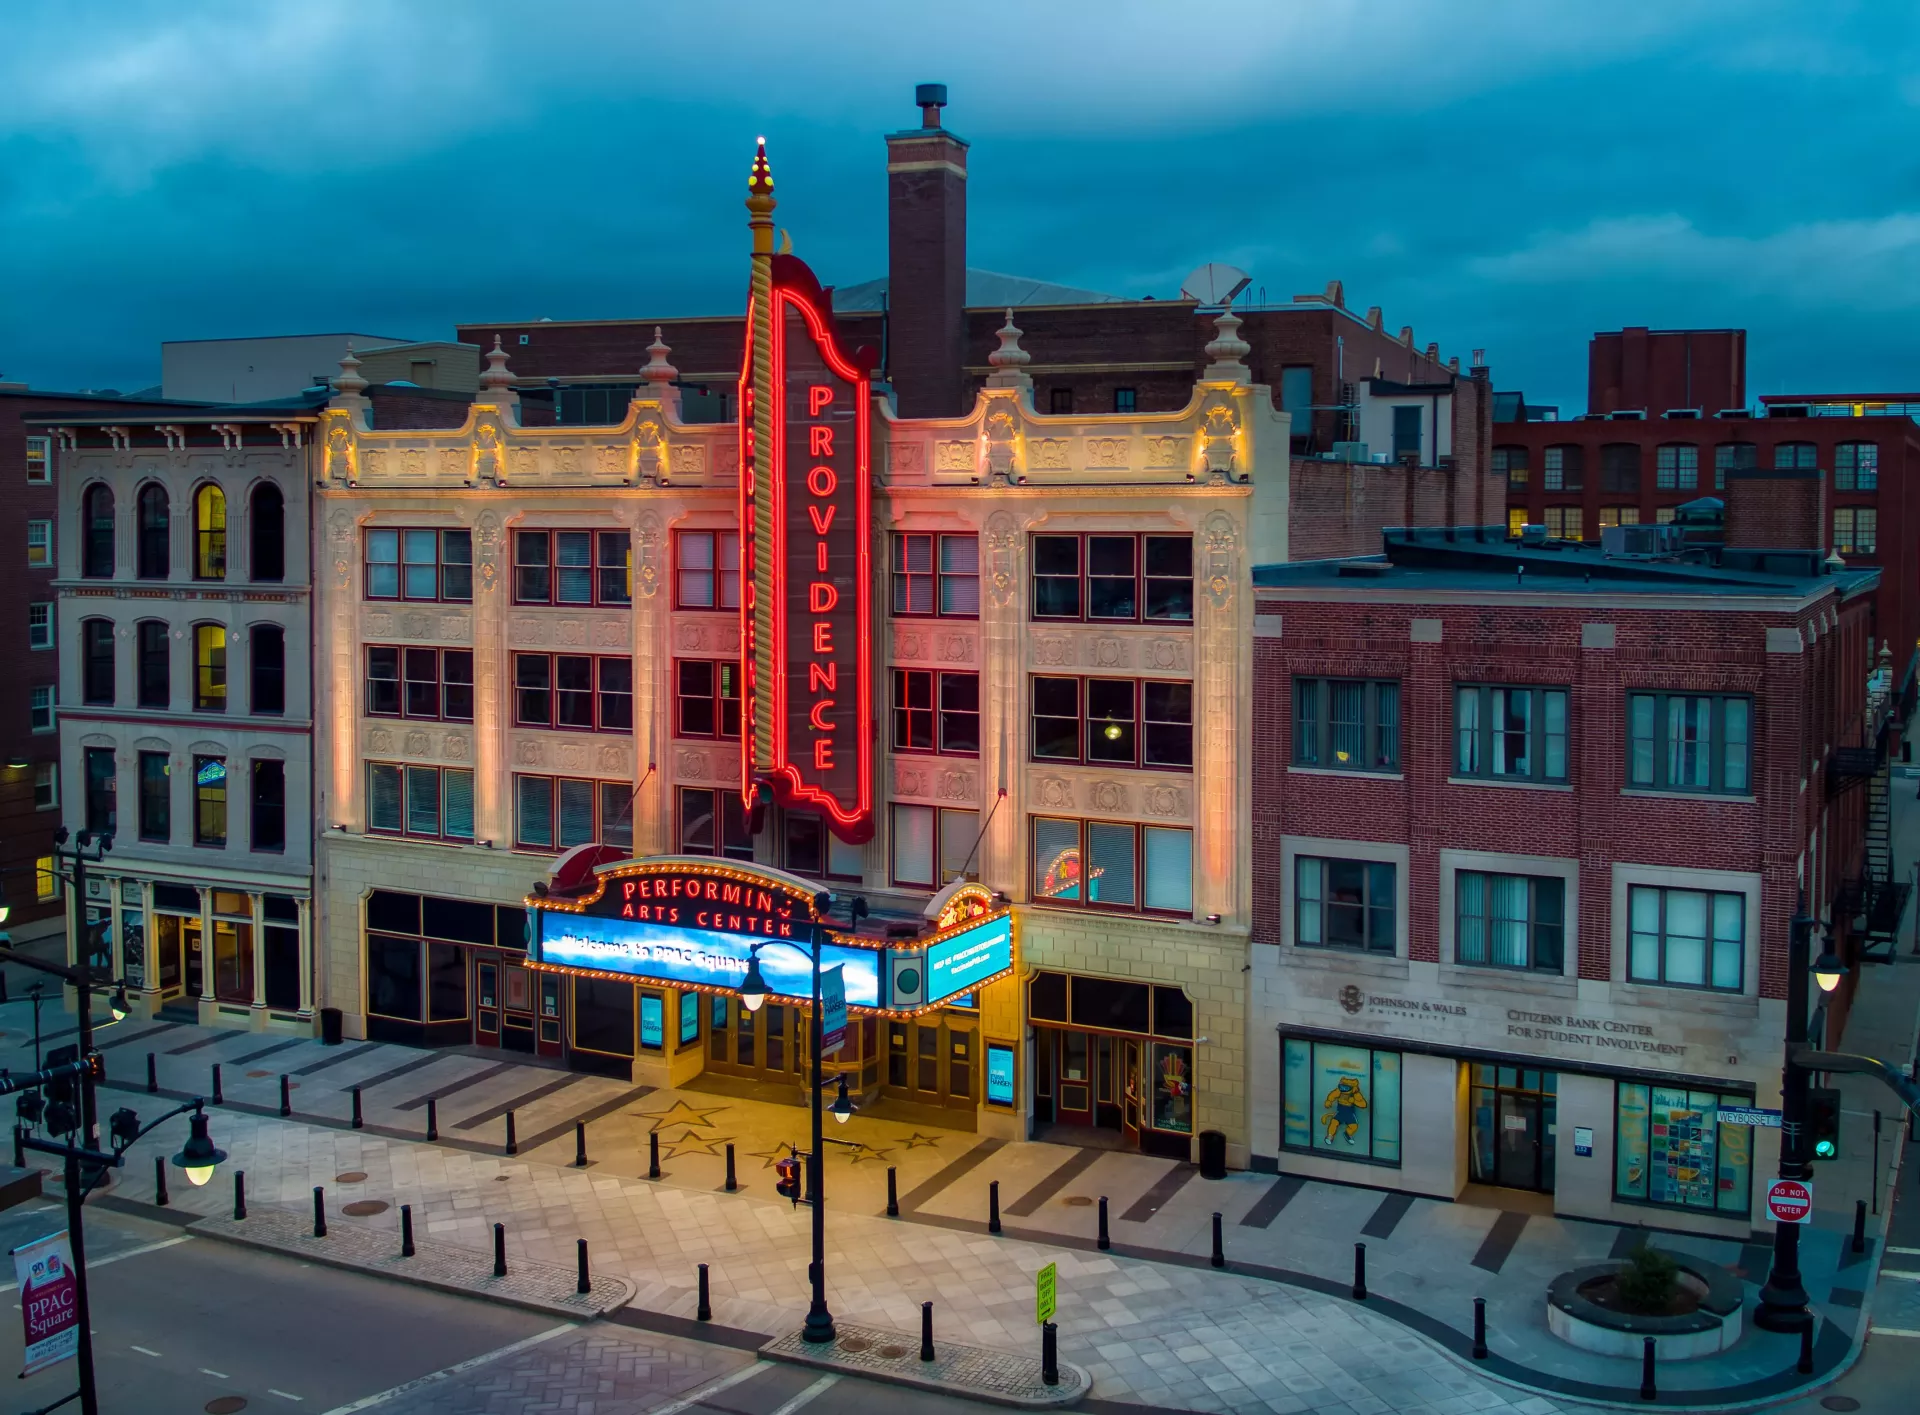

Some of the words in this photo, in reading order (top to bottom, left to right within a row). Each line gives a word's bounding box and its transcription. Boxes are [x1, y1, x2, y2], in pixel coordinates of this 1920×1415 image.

[807, 385, 838, 770] PROVIDENCE
[622, 902, 679, 923] ARTS
[696, 911, 792, 937] CENTER
[562, 934, 628, 956] Welcome
[635, 942, 649, 960] to
[696, 950, 750, 974] Square
[1368, 995, 1419, 1010] JOHNSON
[1421, 1002, 1431, 1012] &
[1432, 1003, 1467, 1016] WALES
[1368, 1008, 1447, 1022] UNIVERSITY
[1507, 1009, 1563, 1025] CITIZENS
[1566, 1016, 1600, 1030] BANK
[1603, 1021, 1654, 1037] CENTER
[1507, 1025, 1532, 1038] FOR
[1534, 1027, 1593, 1046] STUDENT
[1596, 1036, 1687, 1056] INVOLVEMENT
[1719, 1111, 1770, 1125] WEYBOSSET
[1790, 1189, 1805, 1197] NOT
[1776, 1206, 1801, 1214] ENTER
[28, 1287, 73, 1321] PPAC
[1042, 1289, 1051, 1299] OFF
[30, 1308, 74, 1335] Square
